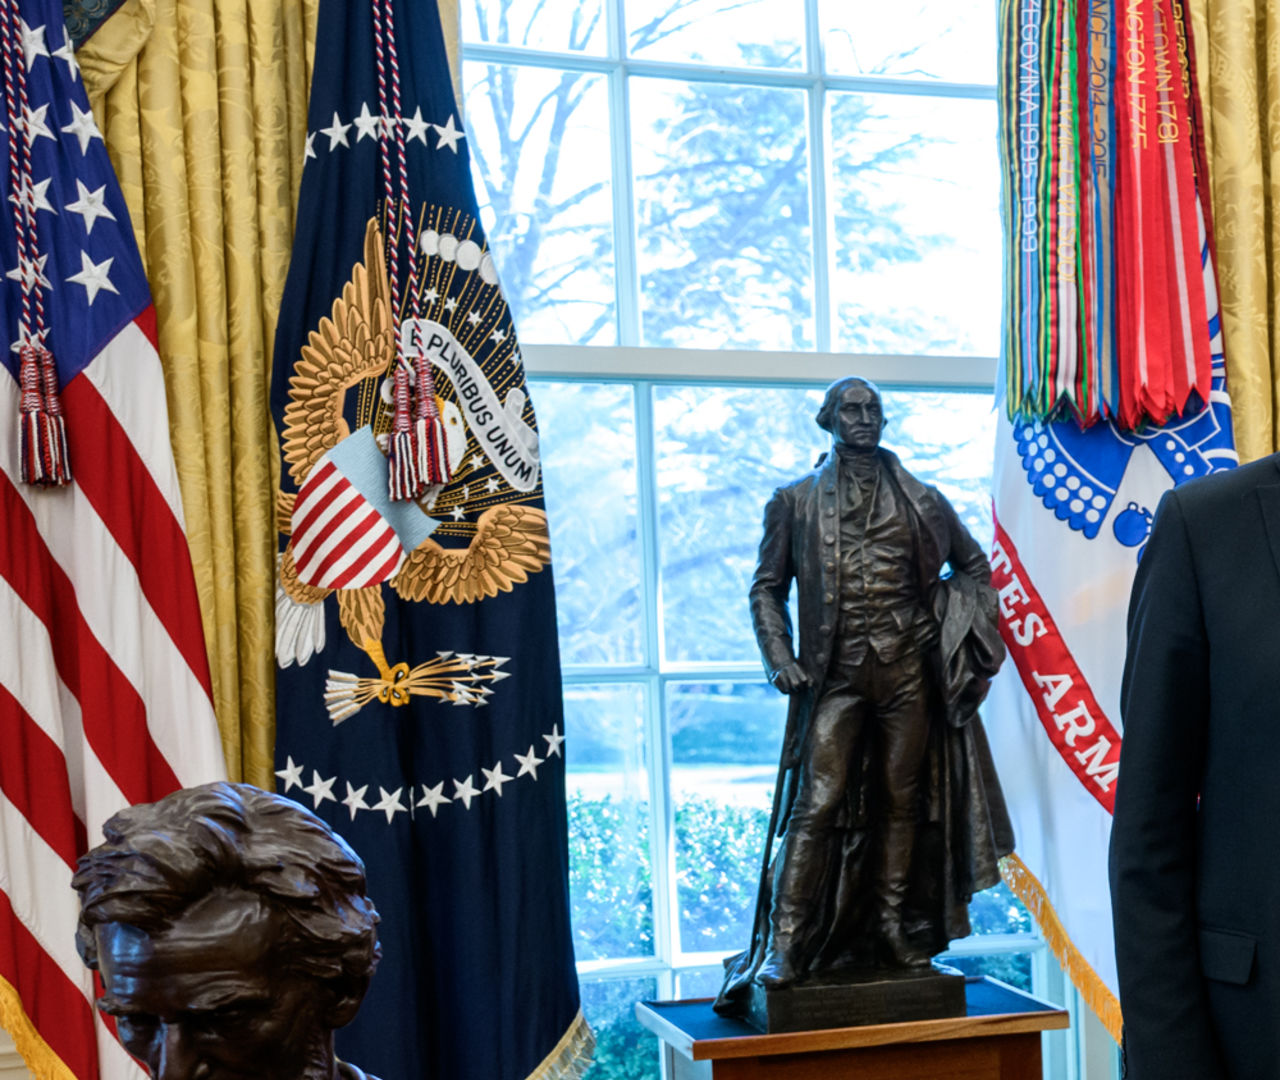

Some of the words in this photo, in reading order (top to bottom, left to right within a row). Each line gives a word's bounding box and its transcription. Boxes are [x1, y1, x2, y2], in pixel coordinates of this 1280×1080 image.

[1128, 93, 1148, 149] 1775
[1156, 101, 1180, 145] 1781
[427, 333, 494, 426] PLURIBUS
[487, 426, 533, 483] UNUM
[1032, 670, 1120, 792] ARM
